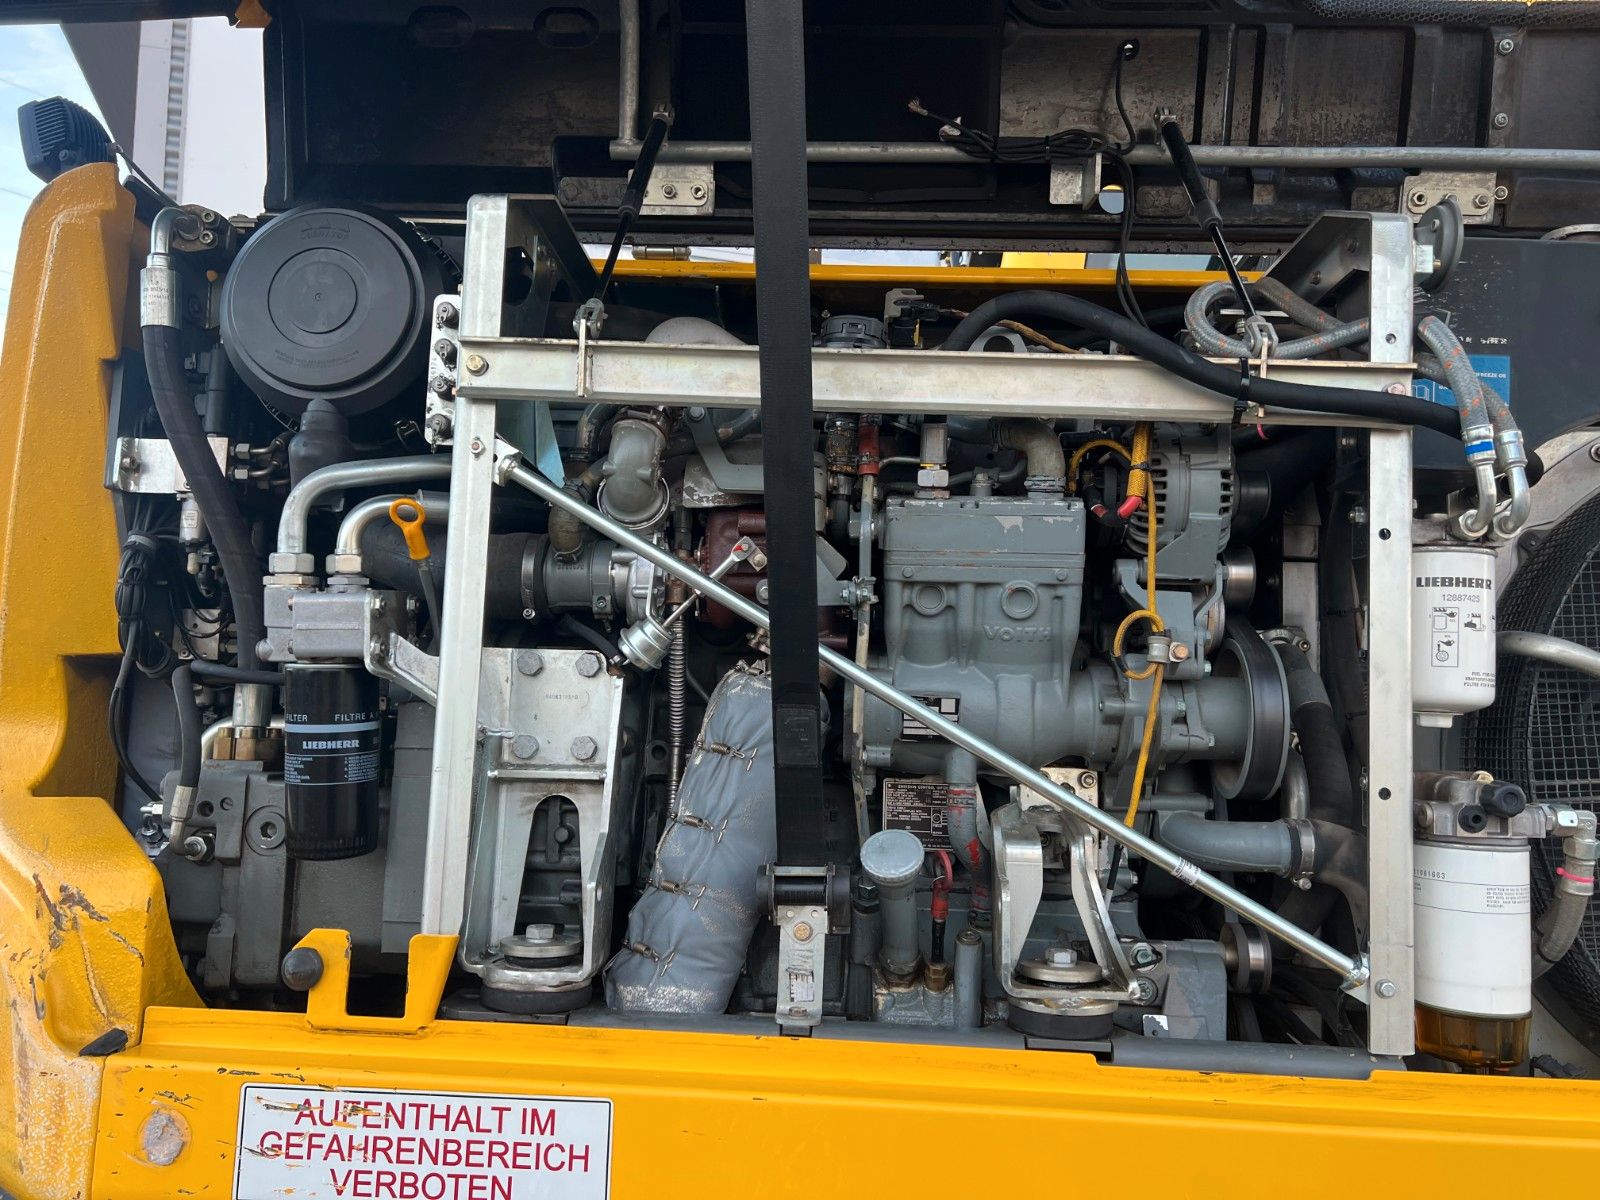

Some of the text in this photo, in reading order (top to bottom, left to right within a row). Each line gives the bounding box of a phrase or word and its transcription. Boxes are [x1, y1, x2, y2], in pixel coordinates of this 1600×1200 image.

[1416, 576, 1492, 590] LIEBHERR
[983, 624, 1053, 642] VOITH
[285, 713, 308, 722] FILTER
[335, 712, 366, 722] FILTRE
[302, 739, 360, 749] LIEBHERR
[521, 1108, 556, 1136] IM
[259, 1130, 590, 1173] GEFAHRENBEREICH
[330, 1168, 512, 1200] VERBOTEN
